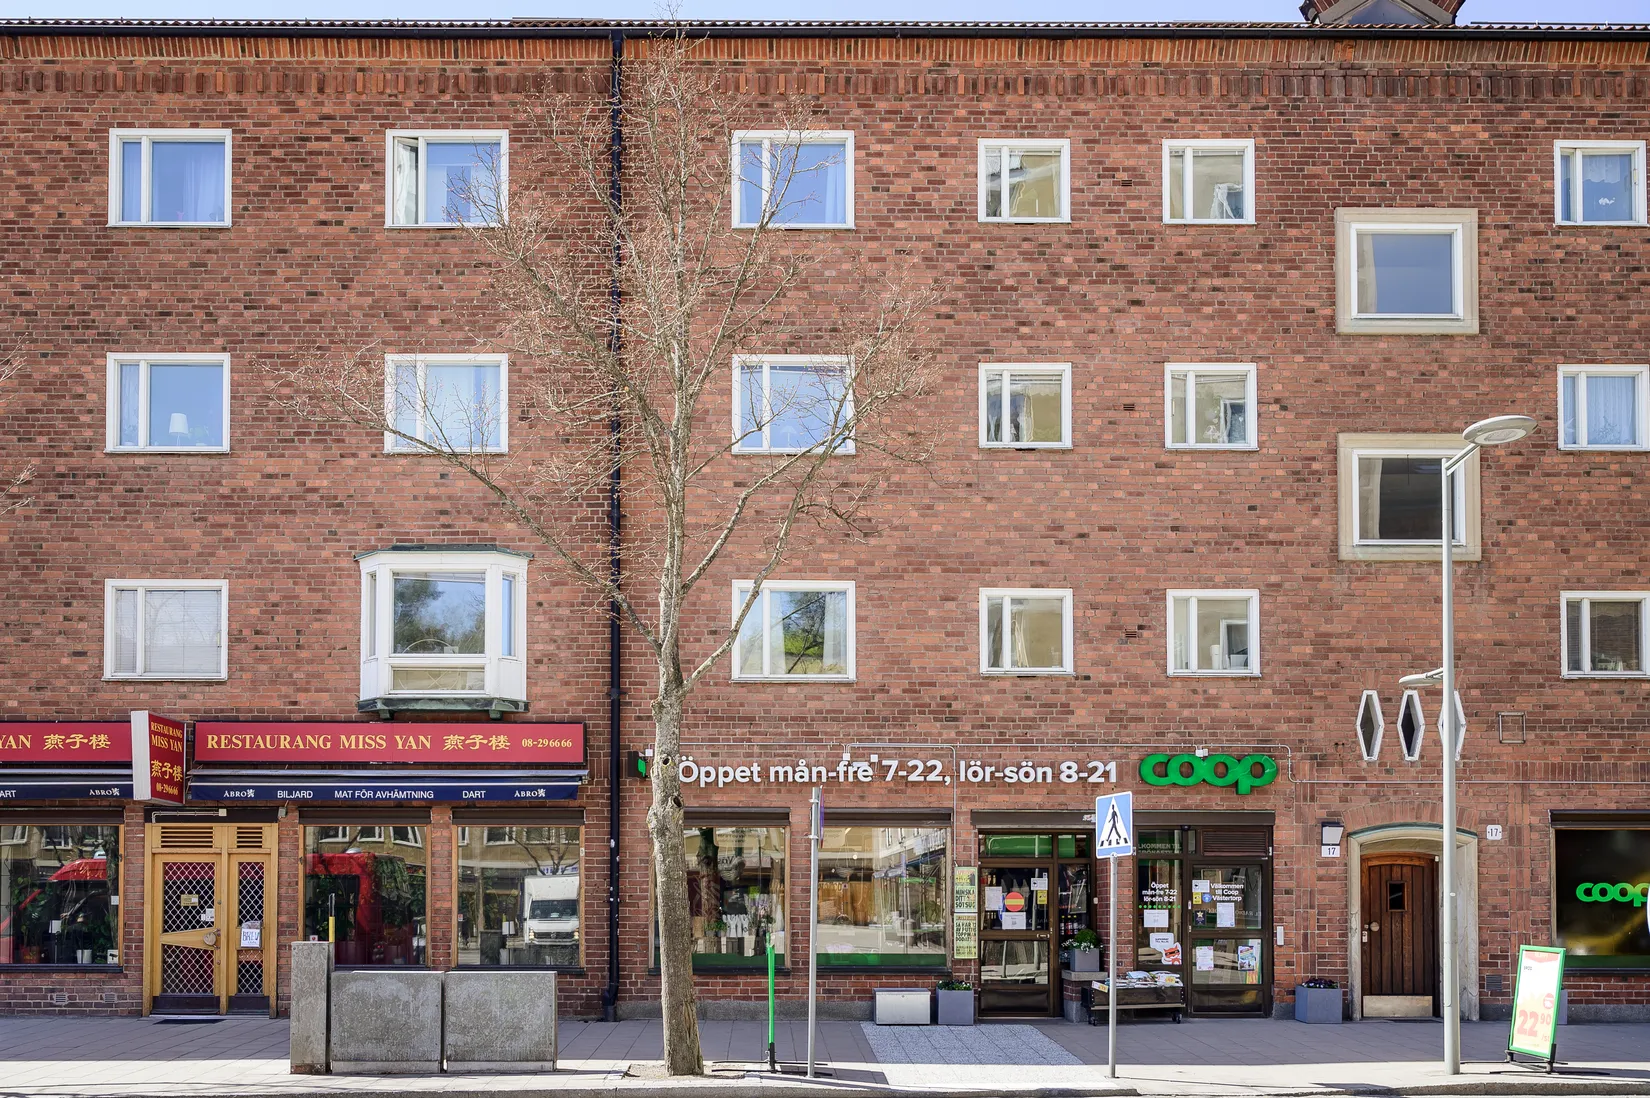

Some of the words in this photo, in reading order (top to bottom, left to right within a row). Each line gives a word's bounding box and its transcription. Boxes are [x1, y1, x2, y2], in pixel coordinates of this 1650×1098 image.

[150, 722, 182, 738] RESTAURANG
[0, 734, 32, 749] YAN
[43, 734, 111, 750] 燕子楼
[151, 734, 168, 749] MISS
[170, 738, 182, 752] YAN
[206, 734, 331, 750] RESTAURANG
[340, 734, 386, 749] MISS
[394, 734, 432, 750] YAN
[442, 734, 510, 751] 燕子楼
[151, 760, 183, 782] 燕子楼
[679, 756, 761, 788] Öppet
[770, 758, 872, 782] mån-fre
[882, 760, 950, 785] 7-22,
[960, 760, 1052, 783] lör-sön
[1059, 760, 1116, 782] 8-21
[1140, 754, 1278, 794] coop
[278, 790, 313, 799] BILJARD
[334, 790, 353, 798] MAT
[355, 789, 373, 798] FÖR
[375, 789, 434, 798] AVHÄMTNING
[462, 790, 486, 799] DART
[1328, 847, 1336, 856] 17
[1576, 882, 1648, 907] coop
[1517, 1009, 1538, 1037] 22
[1540, 1014, 1552, 1025] 90
